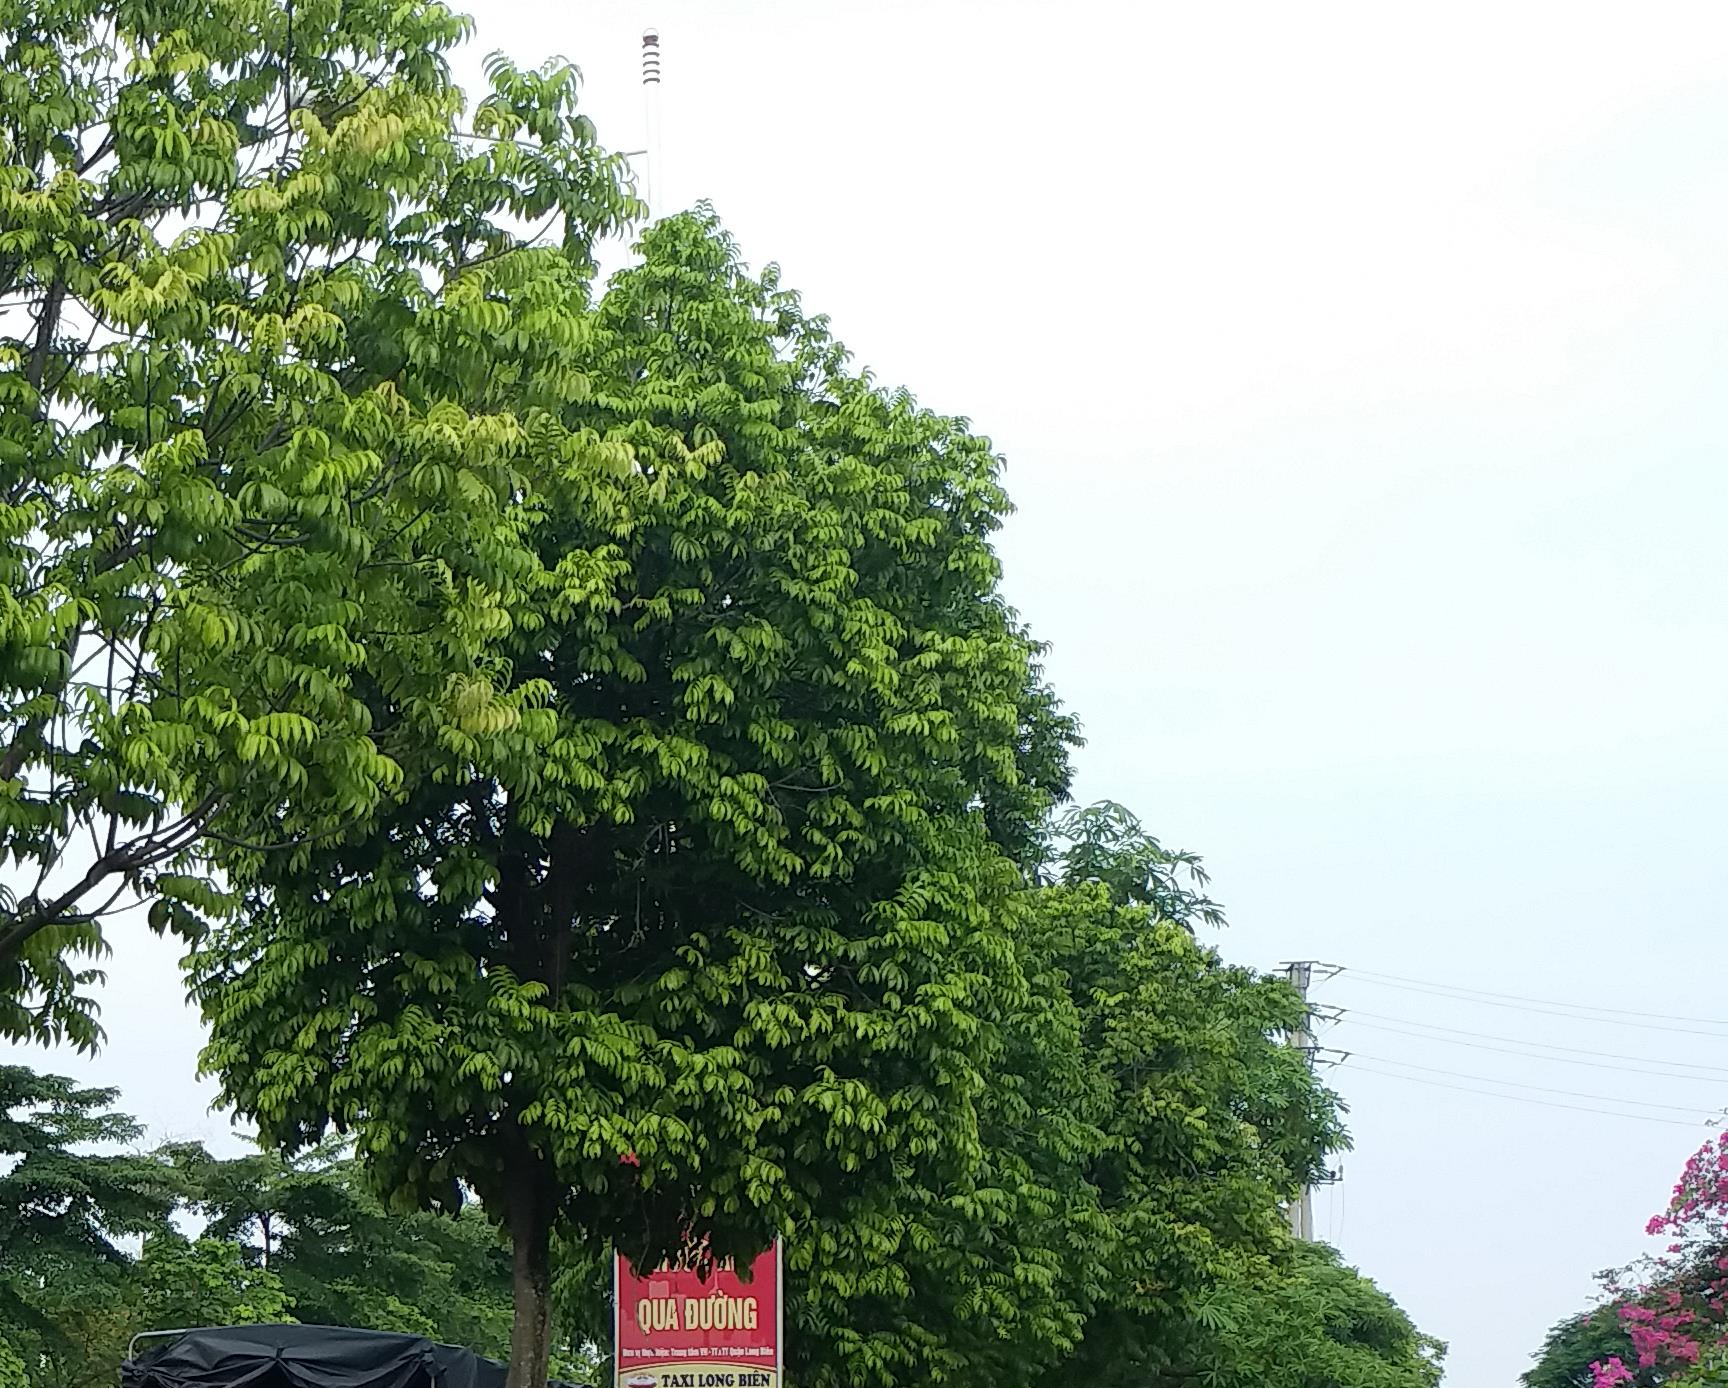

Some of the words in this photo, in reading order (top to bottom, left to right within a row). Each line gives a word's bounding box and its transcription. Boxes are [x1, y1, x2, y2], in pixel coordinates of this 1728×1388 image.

[638, 1298, 680, 1335] QUA
[684, 1290, 758, 1331] ĐƯỜNG
[661, 1374, 694, 1388] TAXI
[698, 1373, 735, 1388] LONG
[738, 1369, 771, 1388] BIÊN
